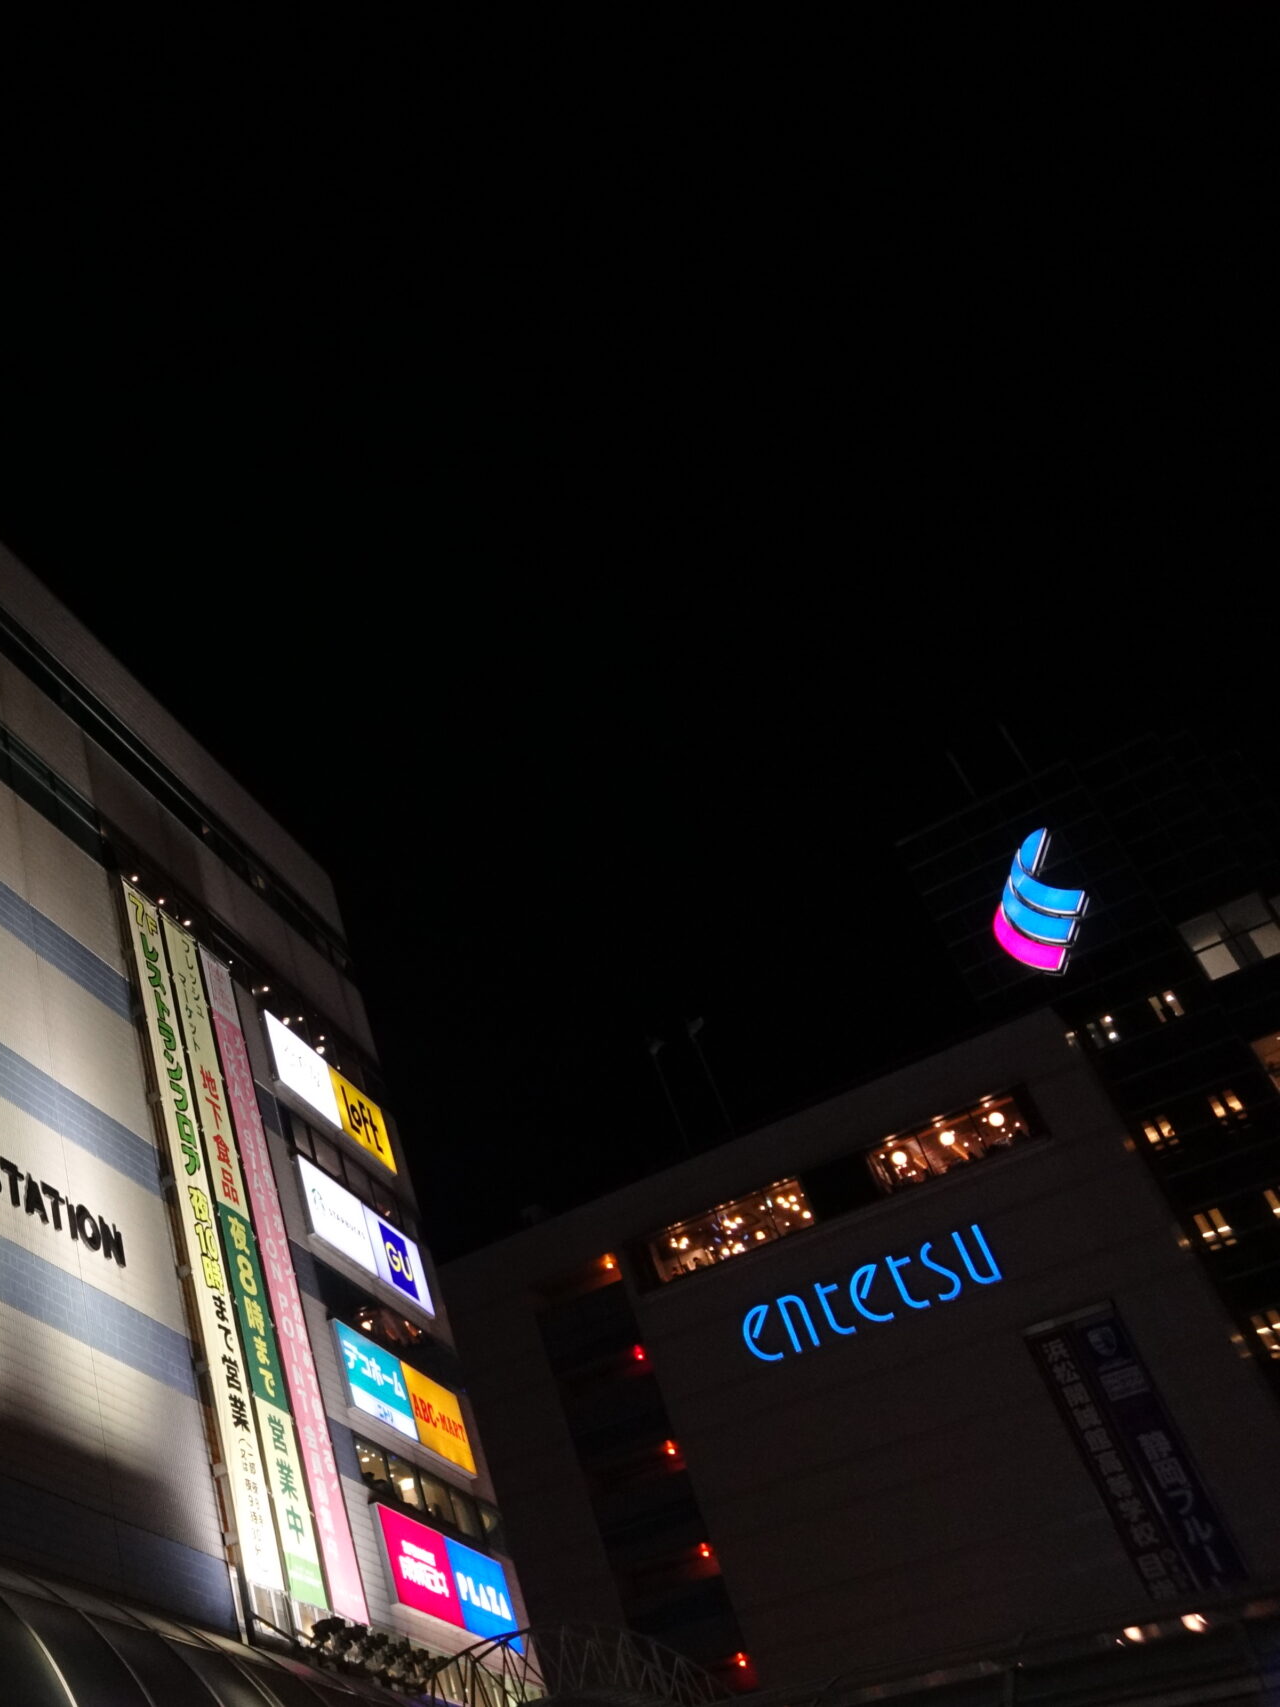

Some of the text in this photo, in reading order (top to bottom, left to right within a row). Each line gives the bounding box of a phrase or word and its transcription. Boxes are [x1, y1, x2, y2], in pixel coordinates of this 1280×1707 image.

[385, 1240, 414, 1282] GU
[742, 1224, 1003, 1361] entetsu
[342, 1339, 407, 1401] デコホーム
[411, 1393, 467, 1443] ABC-MART
[455, 1571, 512, 1621] PLAZA
